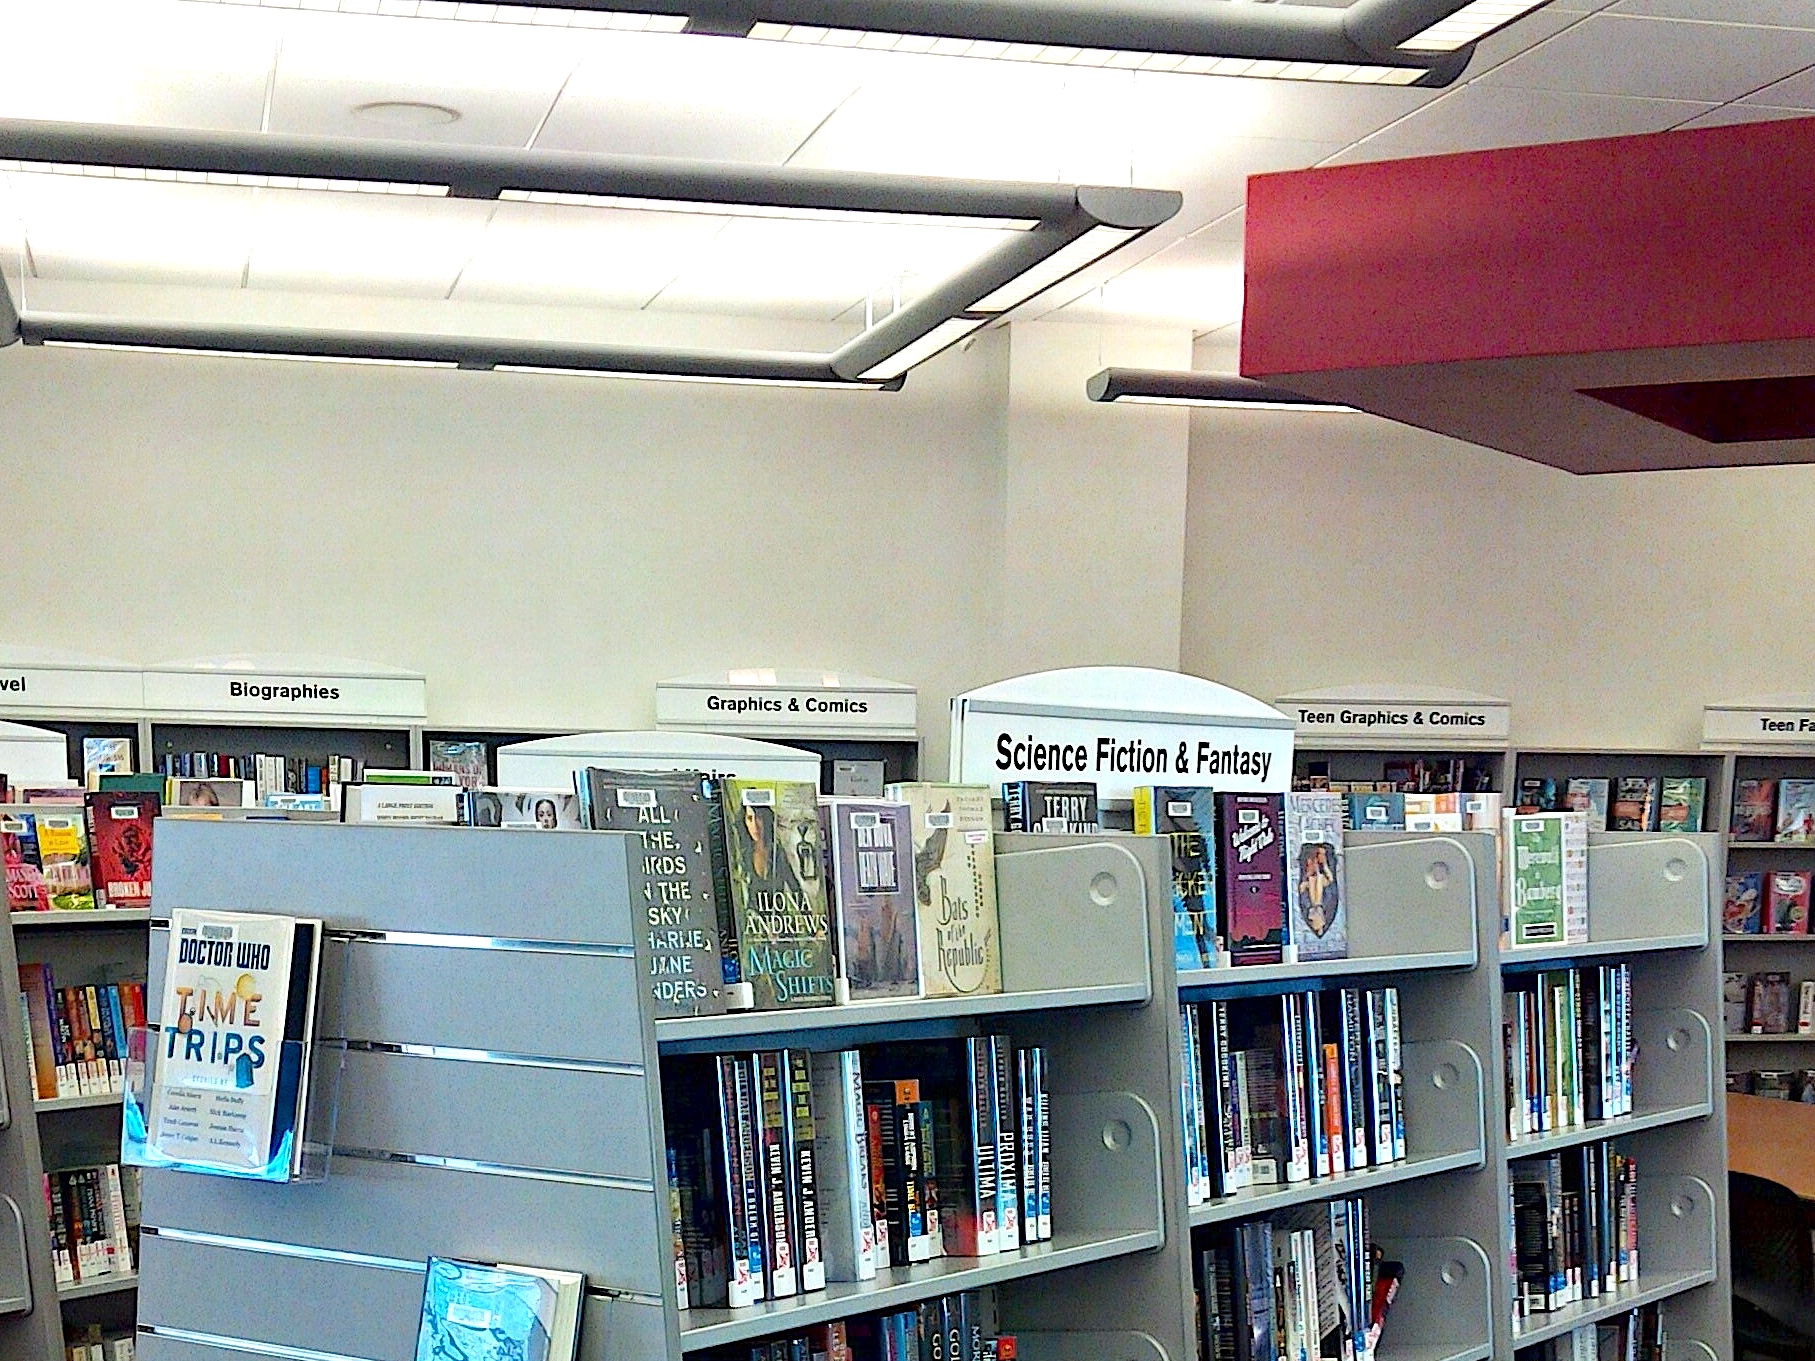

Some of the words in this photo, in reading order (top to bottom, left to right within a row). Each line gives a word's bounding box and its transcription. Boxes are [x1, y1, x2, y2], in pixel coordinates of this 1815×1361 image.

[0, 676, 26, 692] vel
[229, 680, 341, 702] Biographies
[706, 695, 783, 715] Graphics
[787, 697, 800, 713] &
[805, 697, 868, 714] Comics
[1298, 709, 1335, 724] Teen
[1340, 709, 1408, 728] Graphics
[1413, 711, 1424, 725] &
[1429, 711, 1486, 726] Comics
[1760, 718, 1795, 731] Teen
[1798, 718, 1815, 732] Fa
[995, 733, 1087, 771] Science
[1095, 737, 1168, 774] Fiction
[1175, 741, 1190, 774] &
[1196, 741, 1272, 783] Fantasy
[638, 806, 671, 824] ALL
[1044, 796, 1087, 820] TERRY
[641, 831, 674, 850] THE
[658, 882, 692, 901] THE
[758, 891, 813, 912] ILONA
[937, 875, 968, 926] Bats
[649, 906, 682, 925] SKY
[745, 913, 829, 937] ANDREWS
[178, 938, 233, 968] DOCTOR
[236, 941, 271, 970] WHO
[749, 946, 814, 977] MAGIC
[936, 928, 984, 977] Republic
[654, 981, 707, 1000] NDERS
[775, 971, 833, 1002] SHIFTS
[176, 986, 262, 1027] TIME
[165, 1027, 266, 1070] TRIPS
[769, 1144, 781, 1174] KEVIN
[800, 1151, 813, 1184] KEVIN
[1000, 1132, 1017, 1200] PROXIMA
[978, 1145, 996, 1198] ULTIMA
